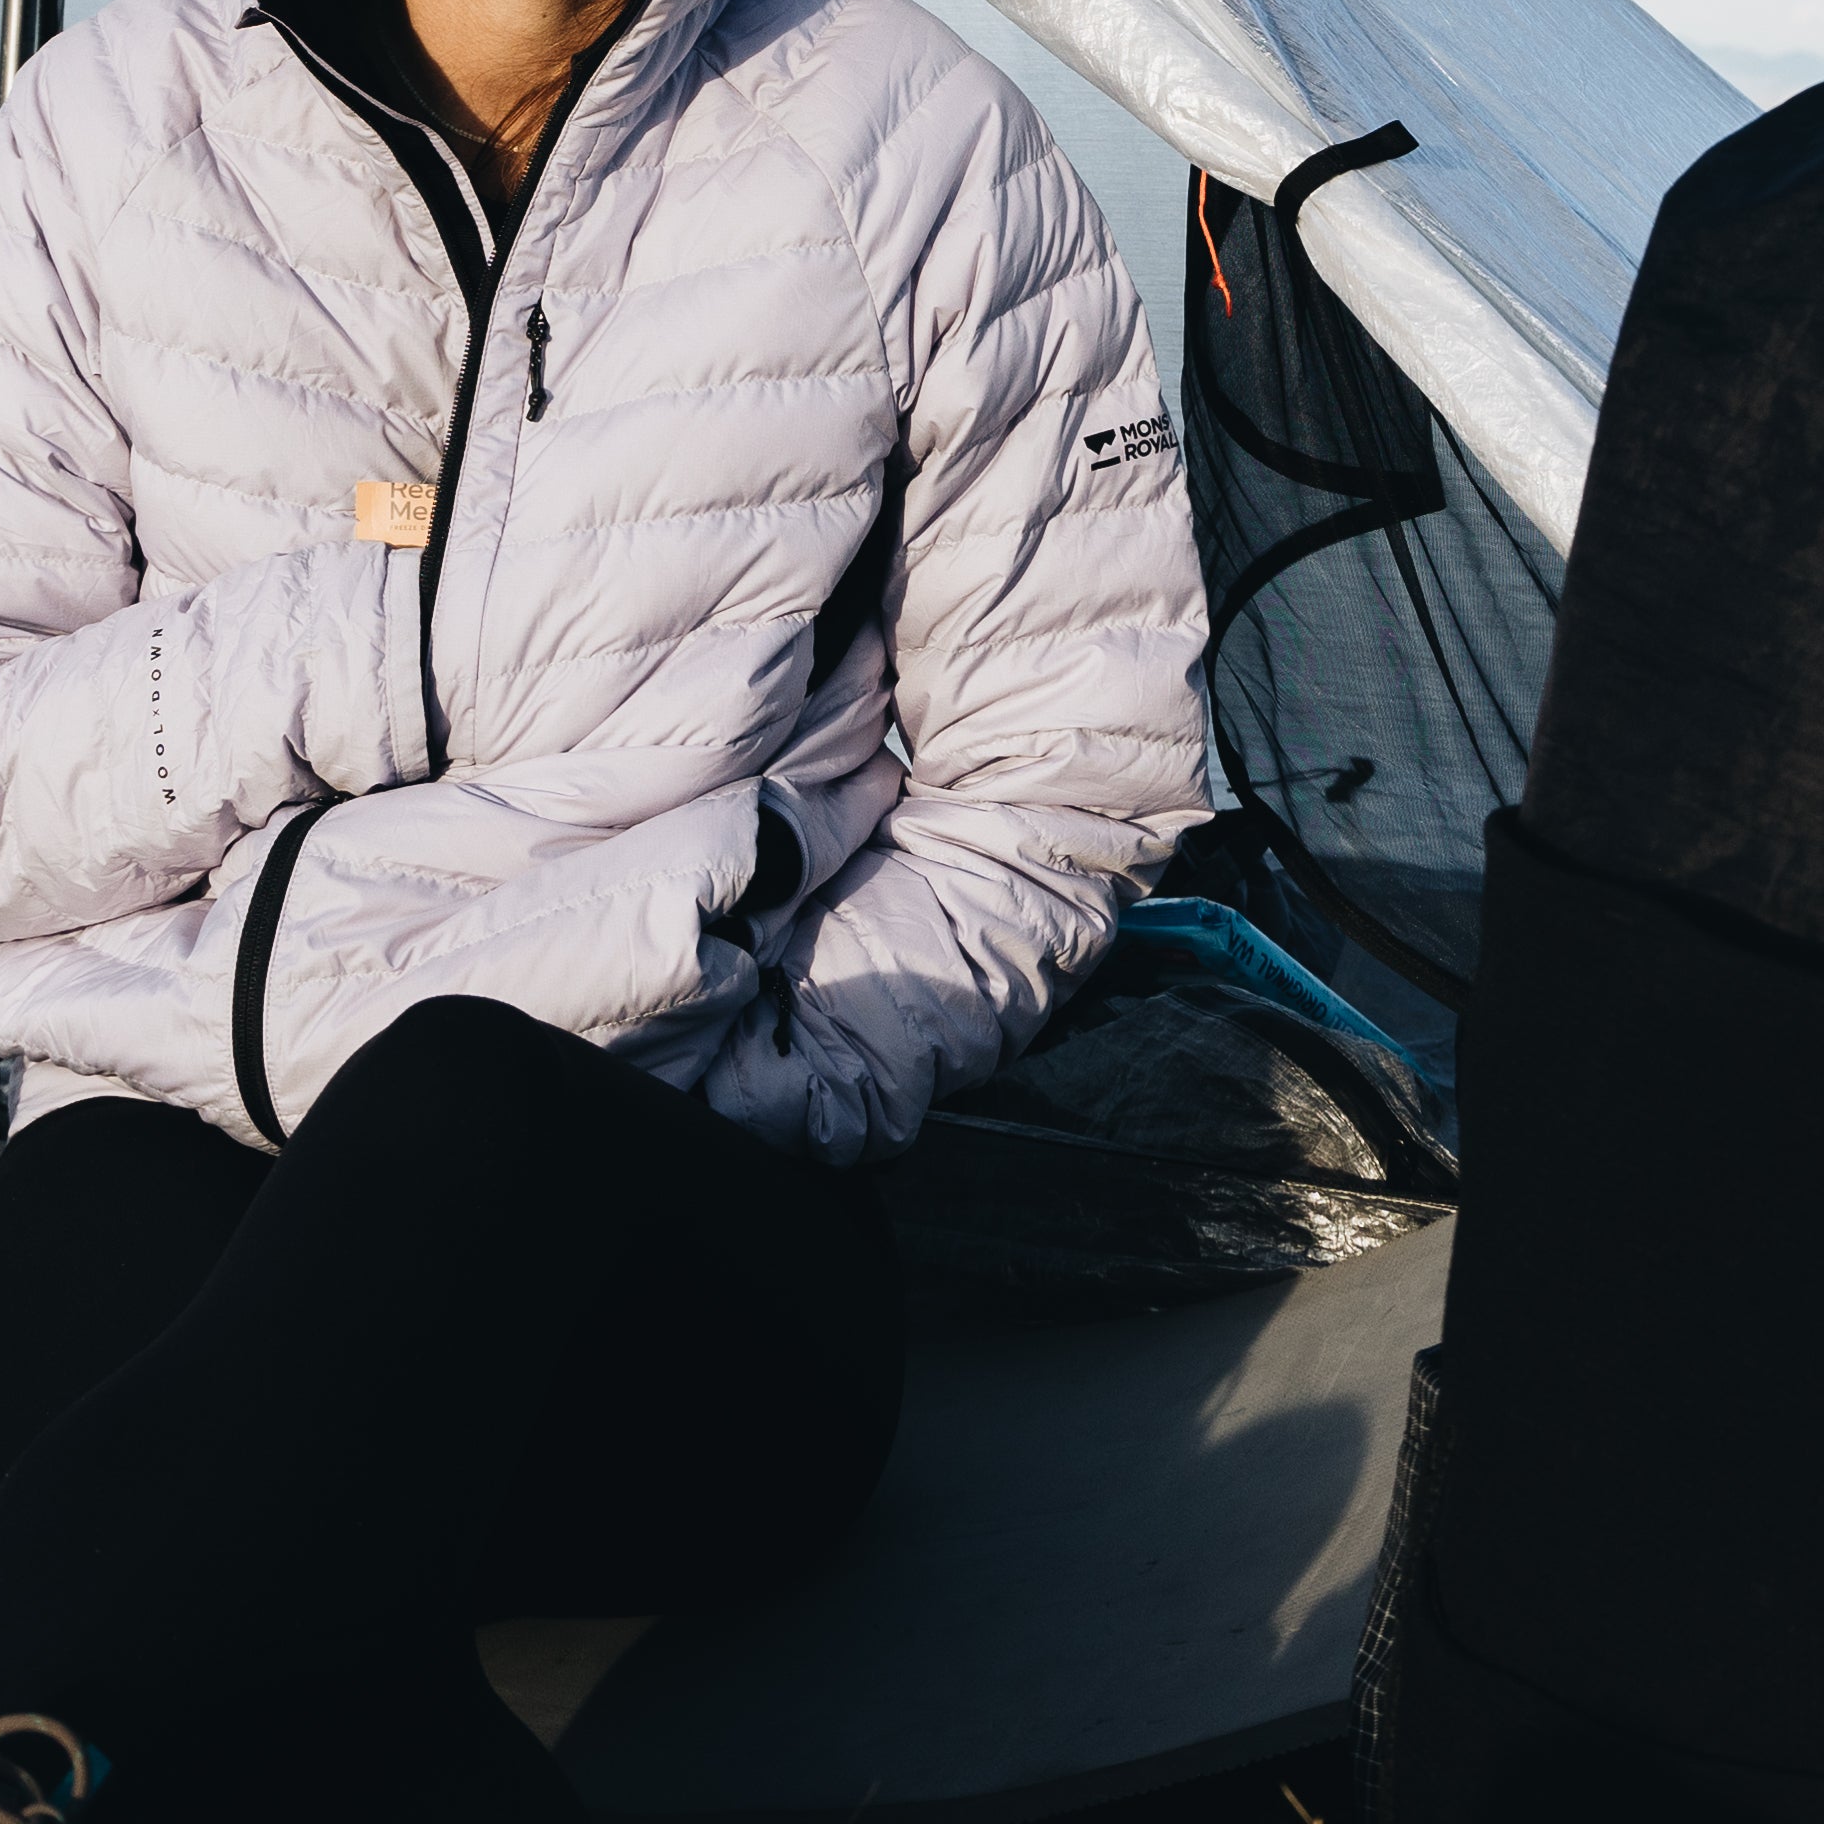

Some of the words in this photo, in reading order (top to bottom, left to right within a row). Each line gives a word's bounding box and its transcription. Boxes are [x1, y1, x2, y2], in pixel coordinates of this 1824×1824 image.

[1119, 413, 1170, 442] MONS
[1124, 431, 1179, 462] ROYAL
[1255, 951, 1327, 1022] ORIGINAL
